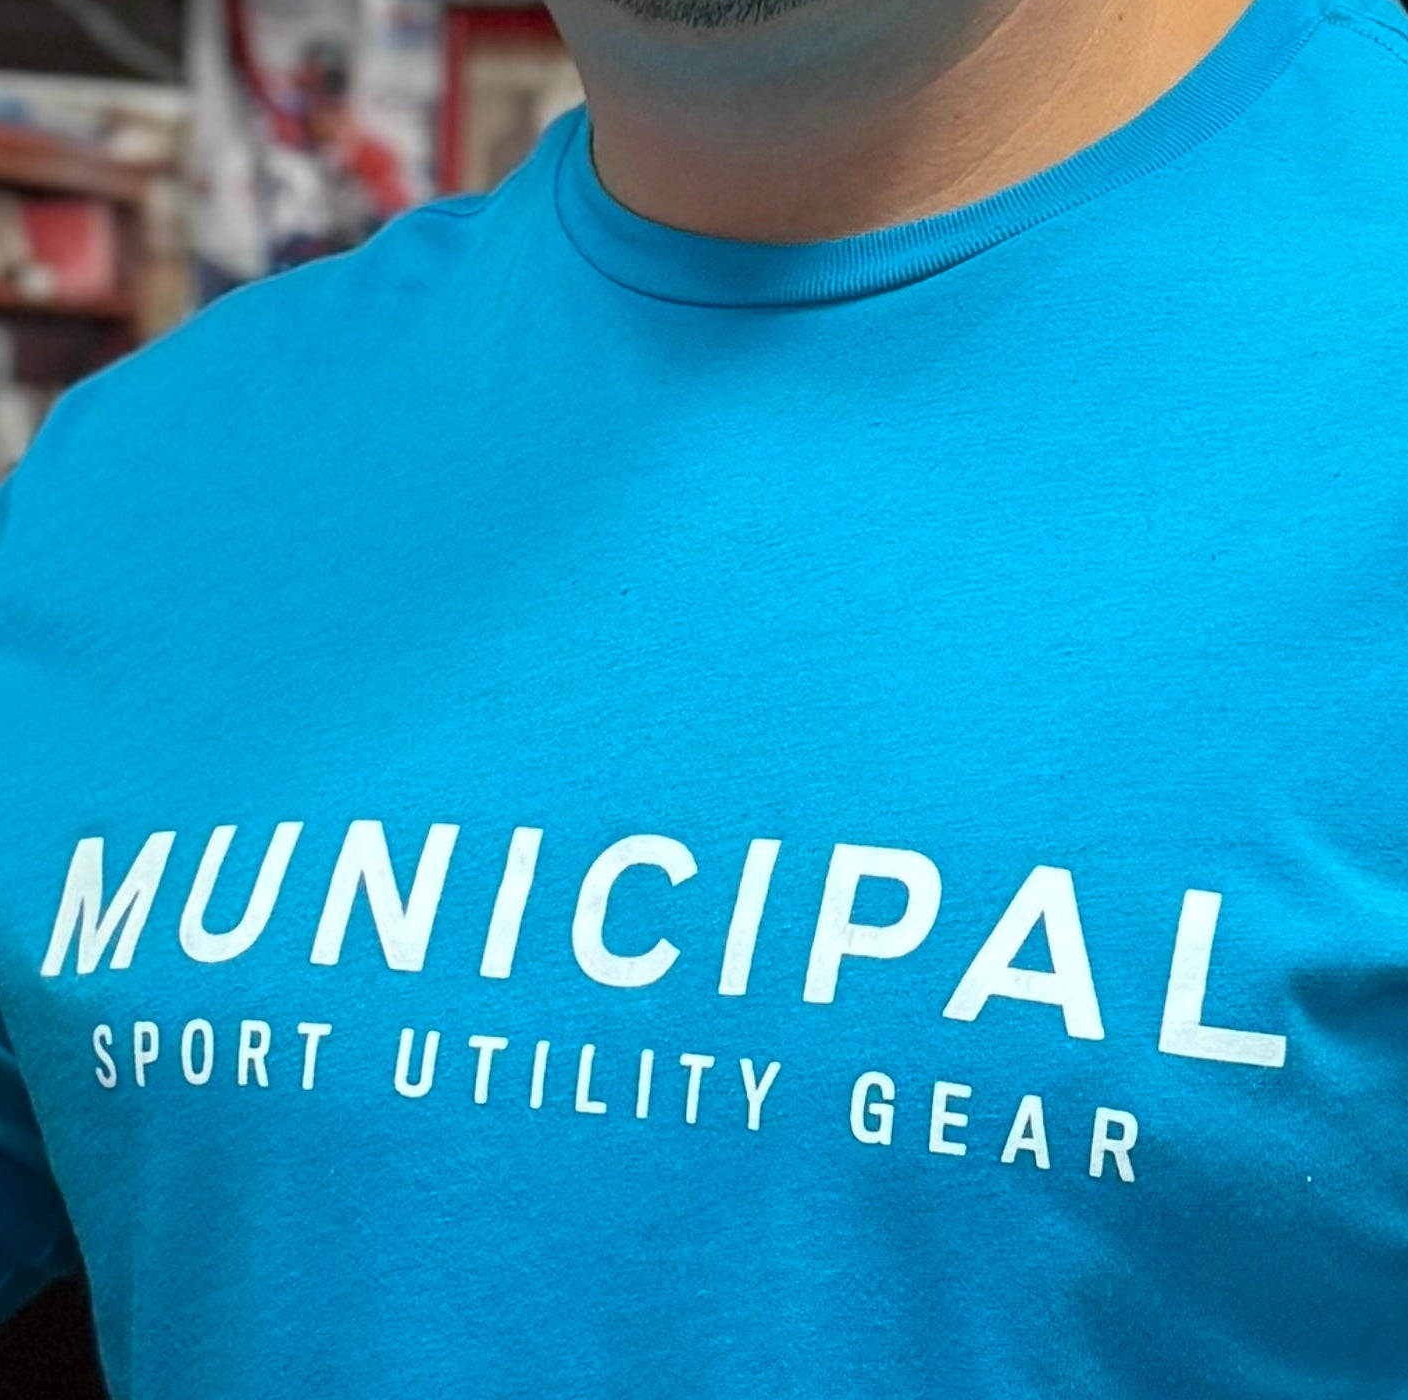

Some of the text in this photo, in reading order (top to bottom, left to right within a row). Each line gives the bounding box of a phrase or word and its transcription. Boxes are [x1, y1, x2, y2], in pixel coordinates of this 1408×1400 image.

[39, 819, 1288, 1068] MUNICIPAL
[94, 1018, 1139, 1183] SPORT UTILITY GEAR
